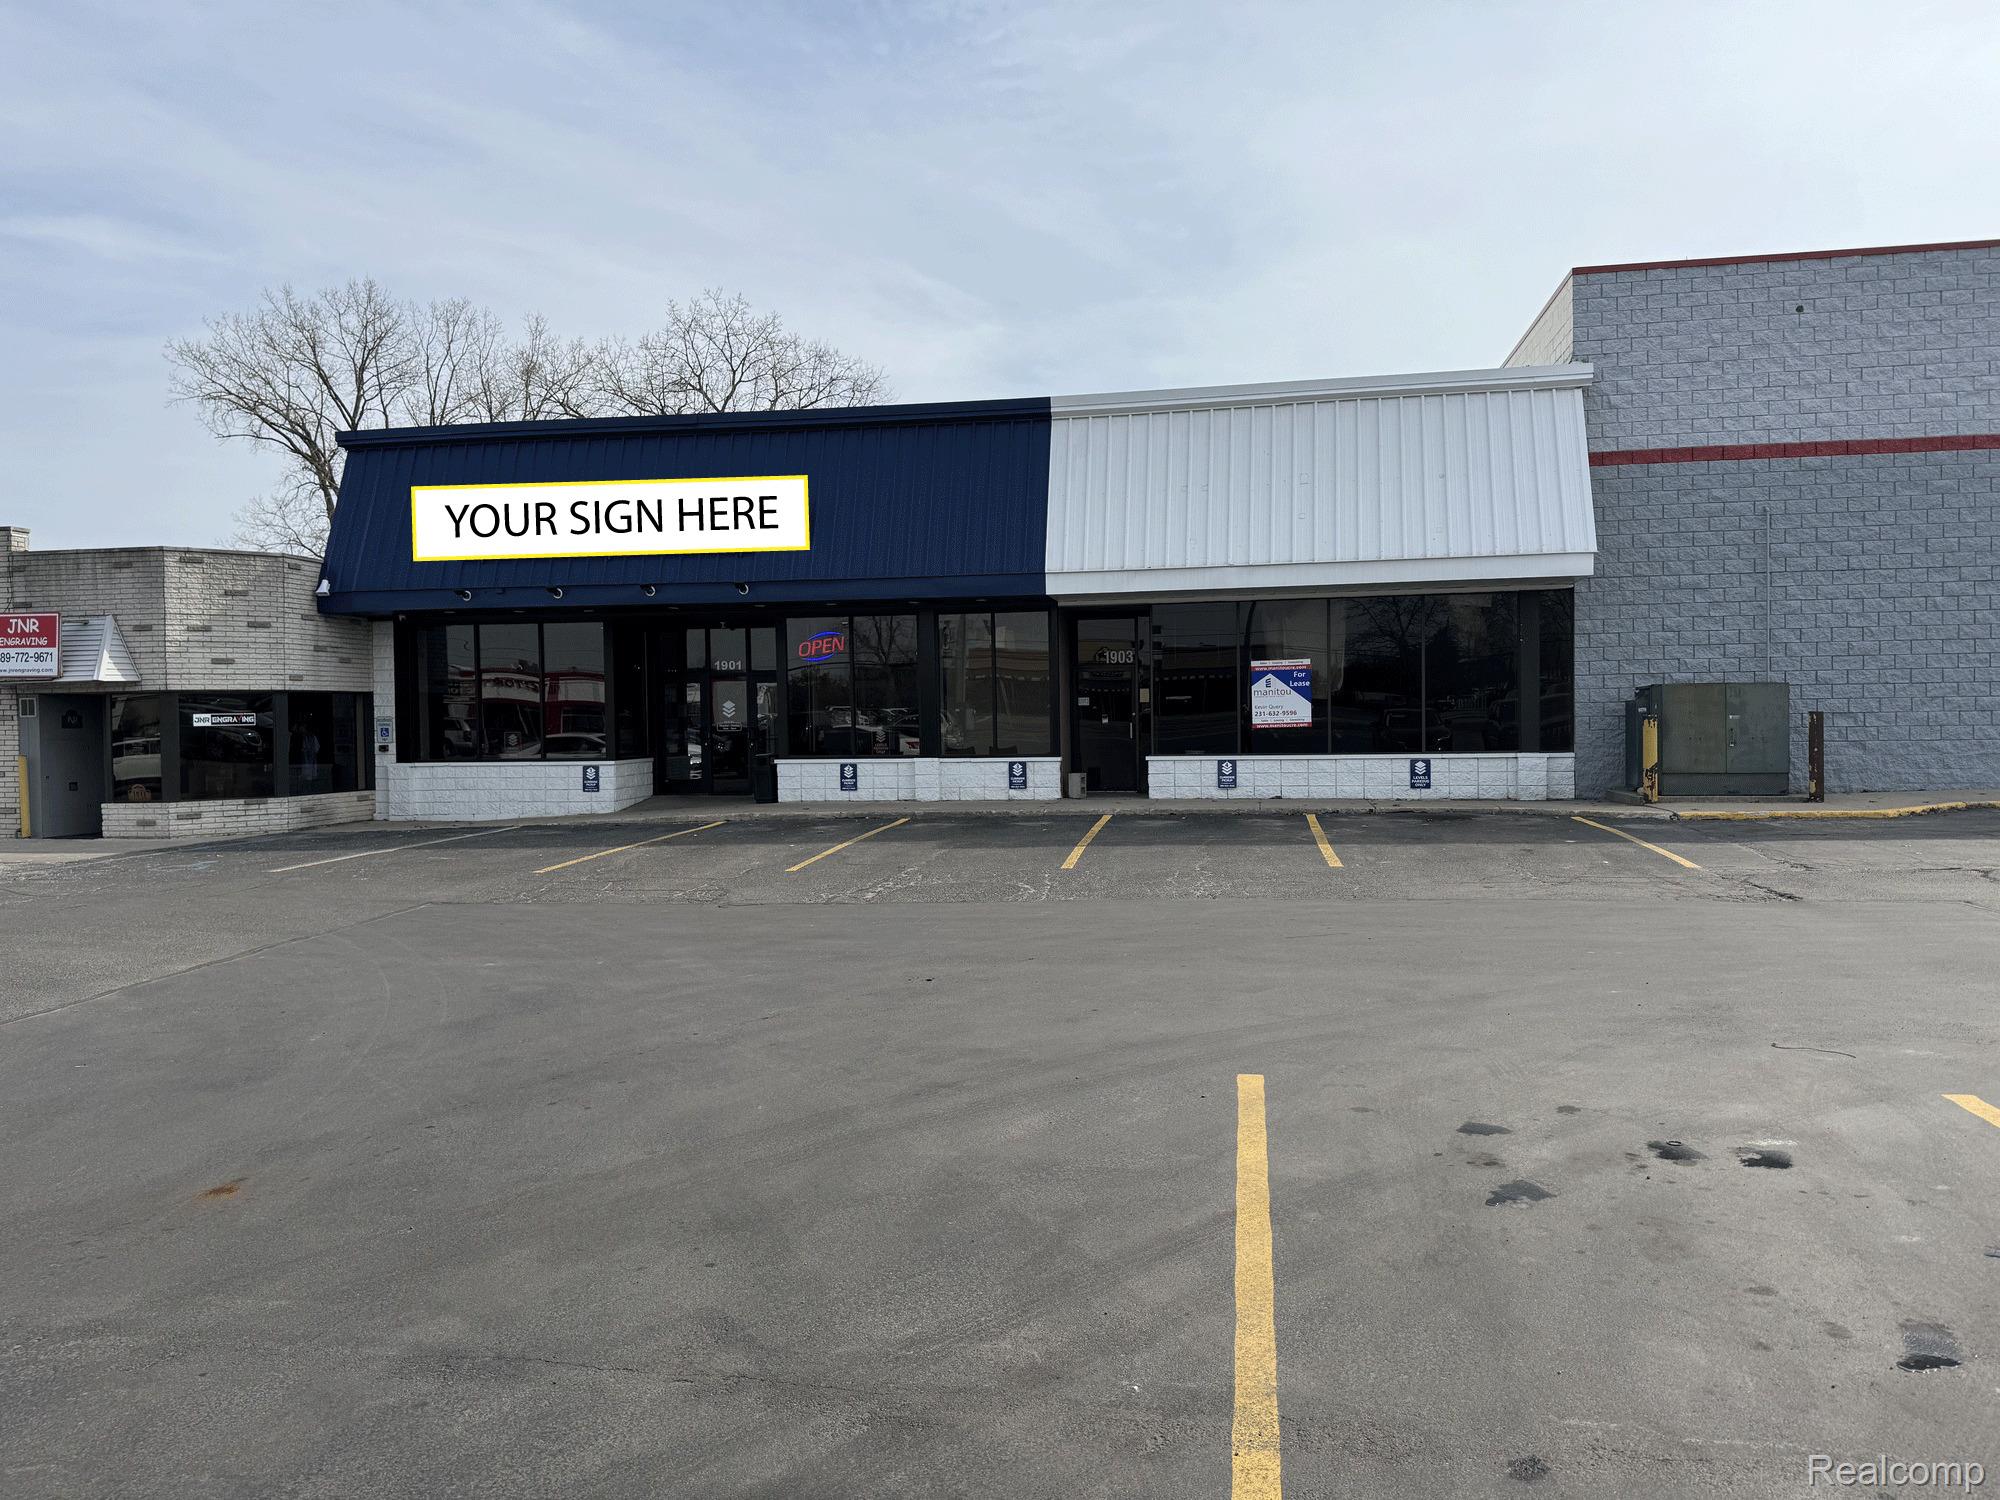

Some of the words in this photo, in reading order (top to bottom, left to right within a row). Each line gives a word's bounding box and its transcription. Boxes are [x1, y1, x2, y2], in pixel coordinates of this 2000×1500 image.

[7, 618, 40, 634] JNR
[0, 637, 48, 646] ENGRAVING
[799, 636, 845, 657] OPEN
[0, 652, 53, 663] 89-772-9671
[1103, 650, 1134, 664] 1903
[714, 660, 742, 671] 1901
[1253, 688, 1292, 696] manitou
